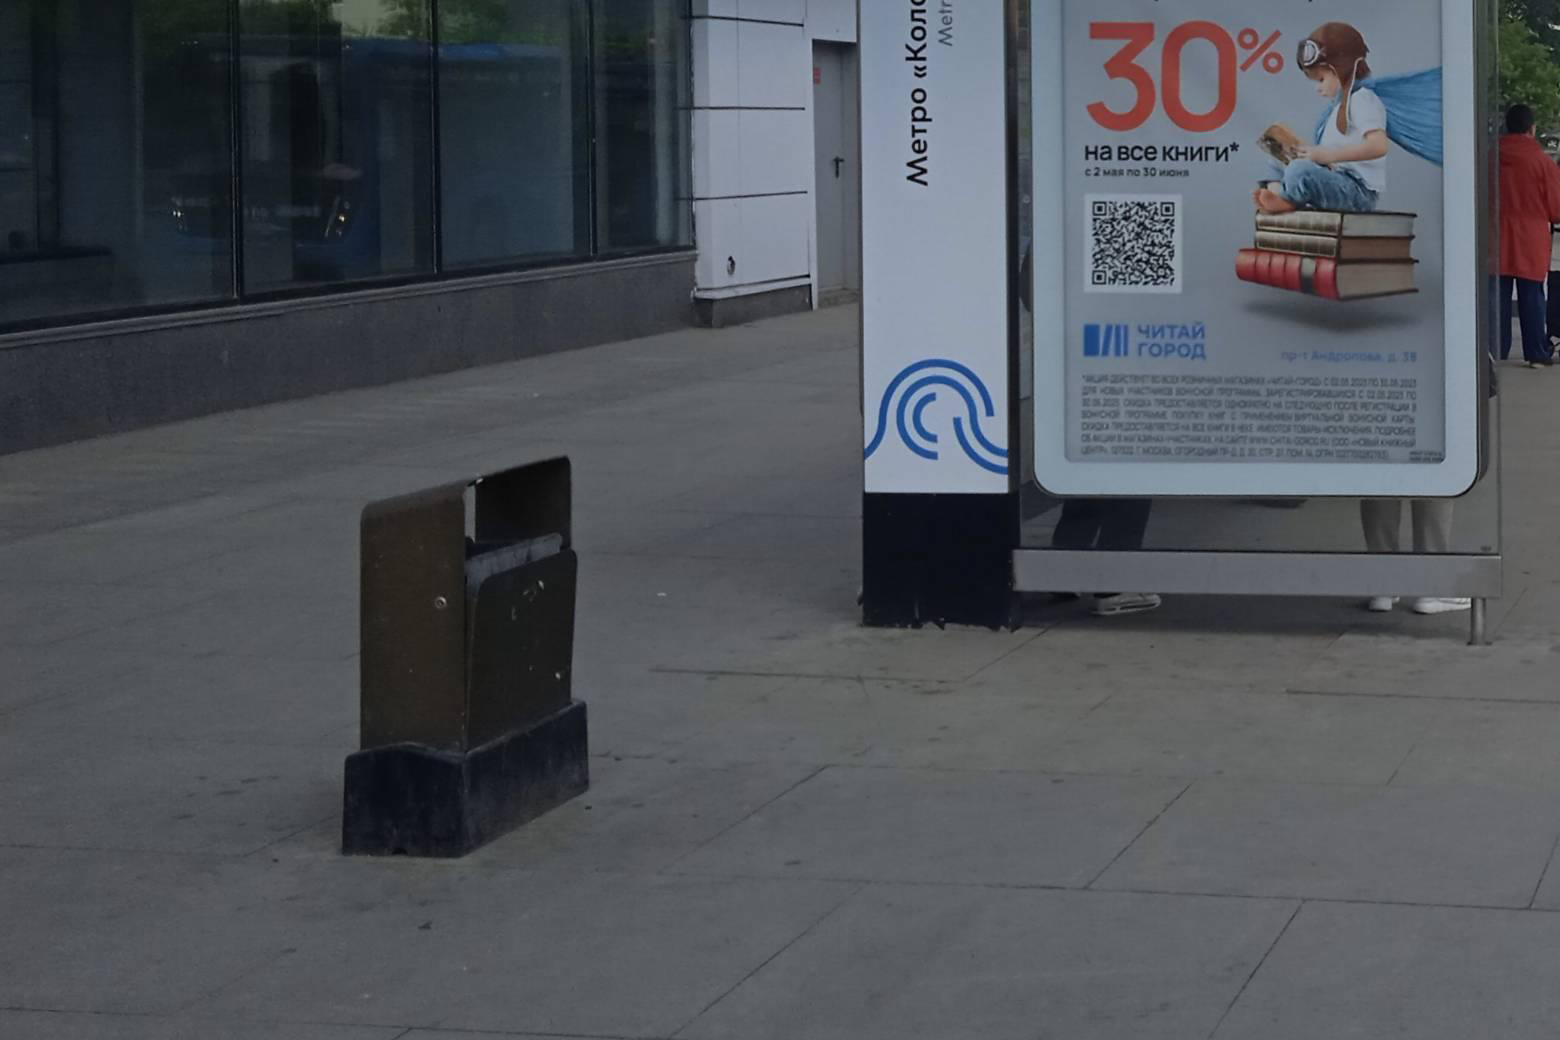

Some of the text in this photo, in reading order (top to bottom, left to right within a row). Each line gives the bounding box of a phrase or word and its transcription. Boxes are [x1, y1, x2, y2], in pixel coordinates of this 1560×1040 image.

[1086, 20, 1284, 132] 30%
[905, 87, 933, 187] Метро
[1085, 145, 1114, 162] на
[1117, 145, 1158, 162] все
[1093, 167, 1101, 177] 2
[1102, 169, 1124, 177] мая
[1126, 169, 1141, 177] по
[1143, 167, 1157, 177] 30
[1158, 169, 1190, 177] июня
[1137, 321, 1206, 339] ЧИТАЙ
[1137, 343, 1207, 360] ГОРОД
